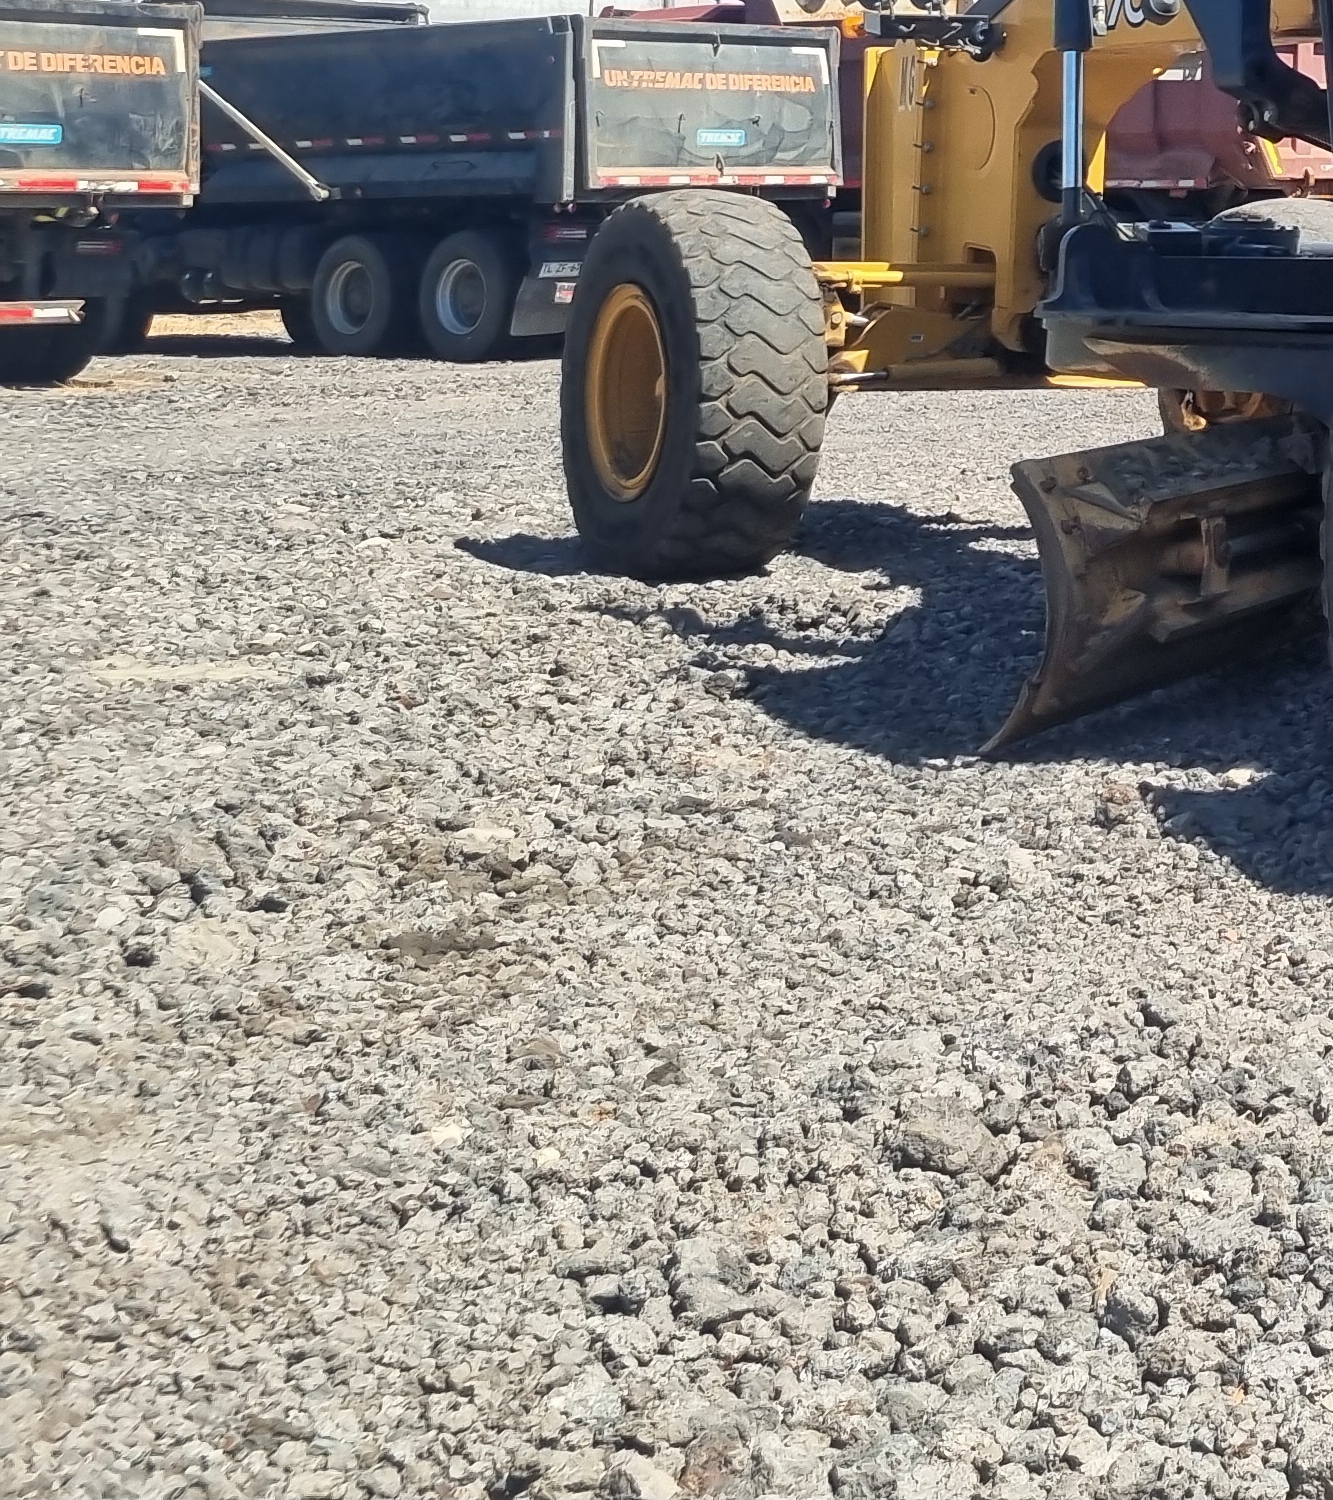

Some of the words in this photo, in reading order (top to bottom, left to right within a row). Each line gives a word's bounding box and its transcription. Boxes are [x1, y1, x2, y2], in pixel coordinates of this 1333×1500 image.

[7, 51, 38, 71] DE
[40, 52, 166, 76] DIFERENCIA
[630, 70, 703, 89] TREMAC
[704, 72, 727, 91] DE
[728, 73, 816, 93] DIFERENCIA
